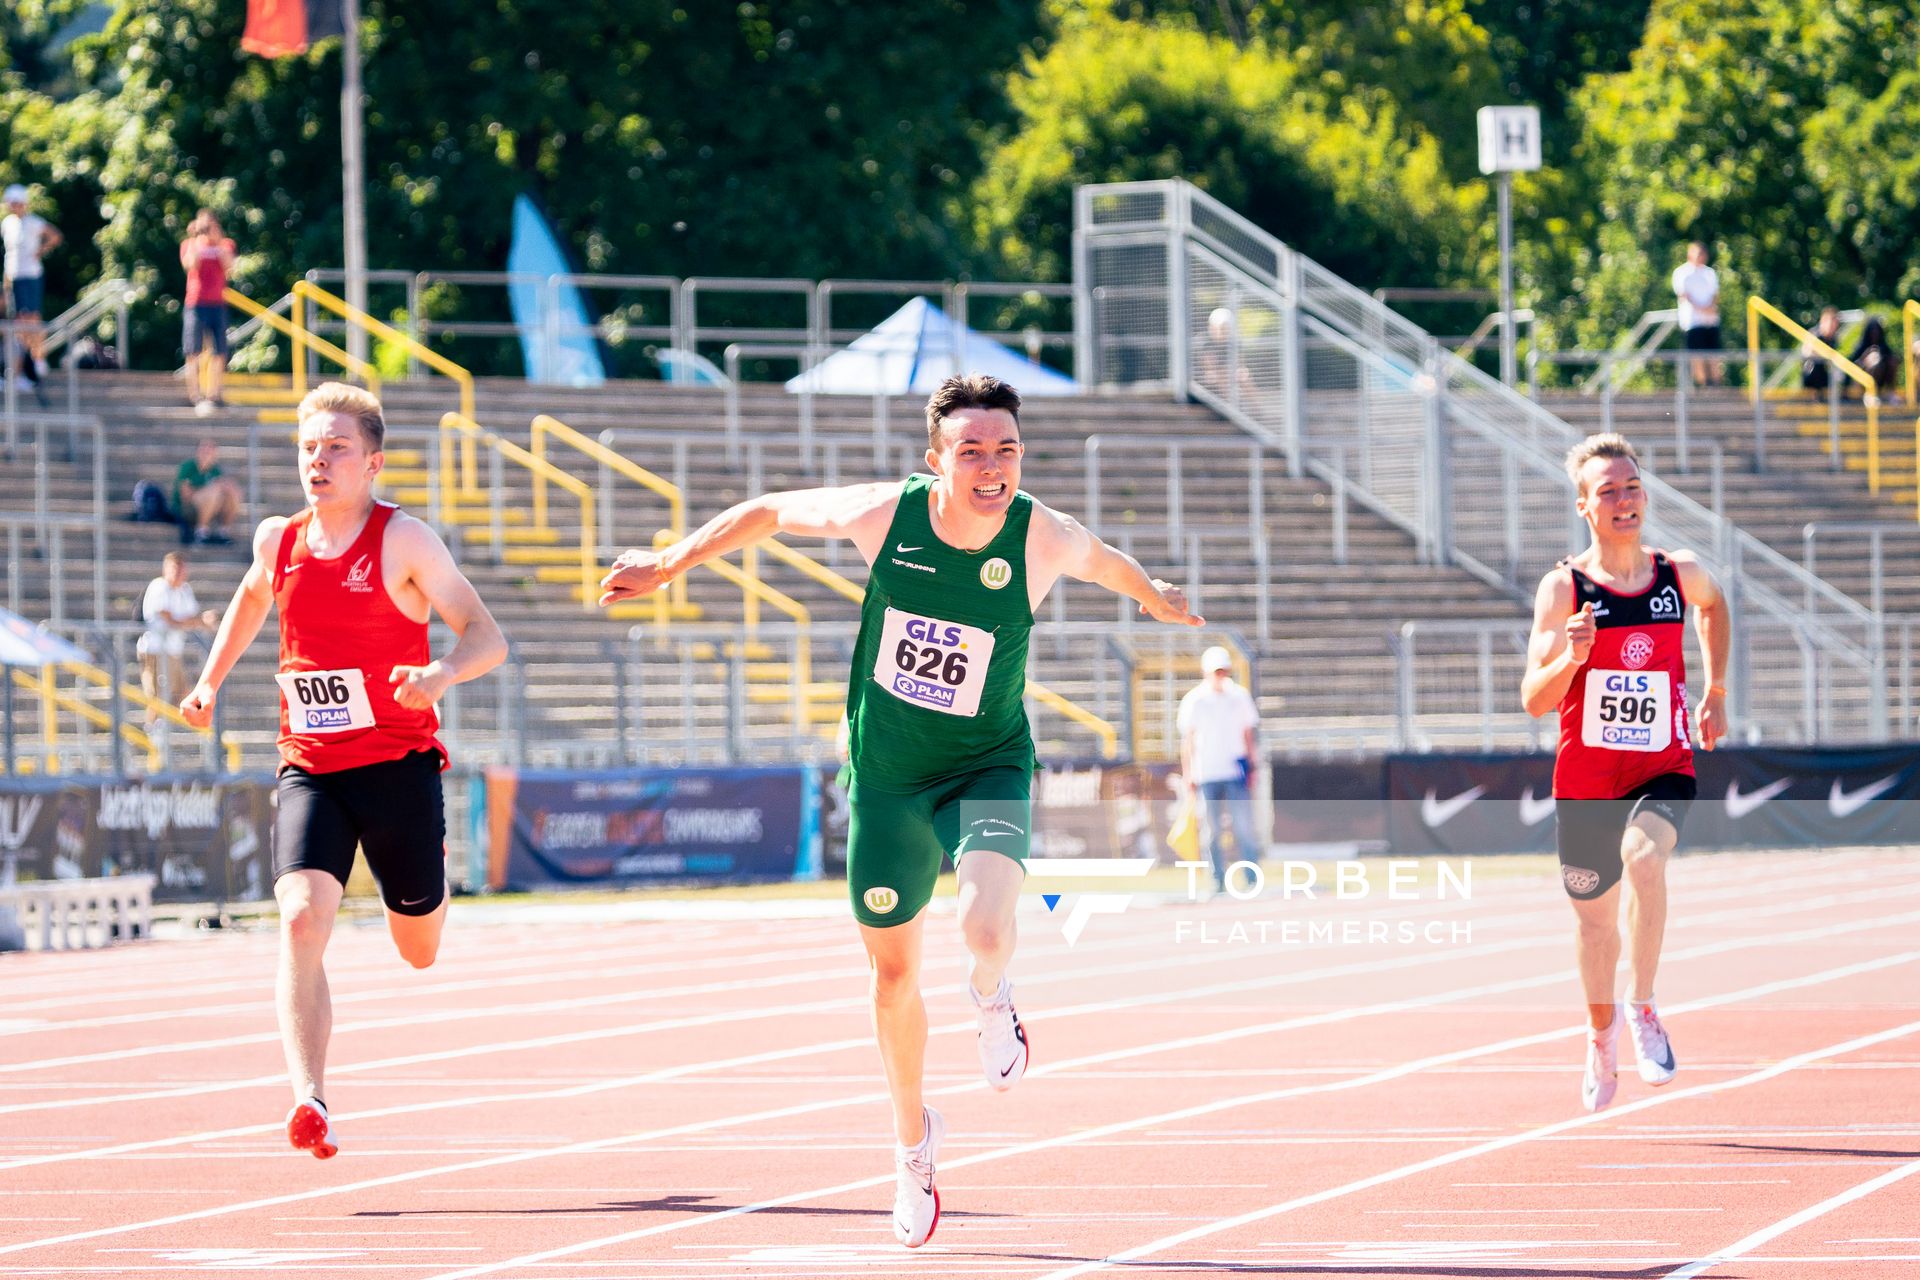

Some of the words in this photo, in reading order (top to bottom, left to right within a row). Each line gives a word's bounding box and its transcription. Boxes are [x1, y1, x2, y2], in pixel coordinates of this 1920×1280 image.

[1502, 118, 1528, 155] H
[1649, 596, 1673, 613] OS
[895, 638, 969, 686] 626
[294, 675, 350, 705] 606
[917, 684, 953, 702] PLAN
[321, 710, 349, 721] PLAN
[1599, 695, 1657, 724] 596
[1621, 728, 1650, 740] PLAN
